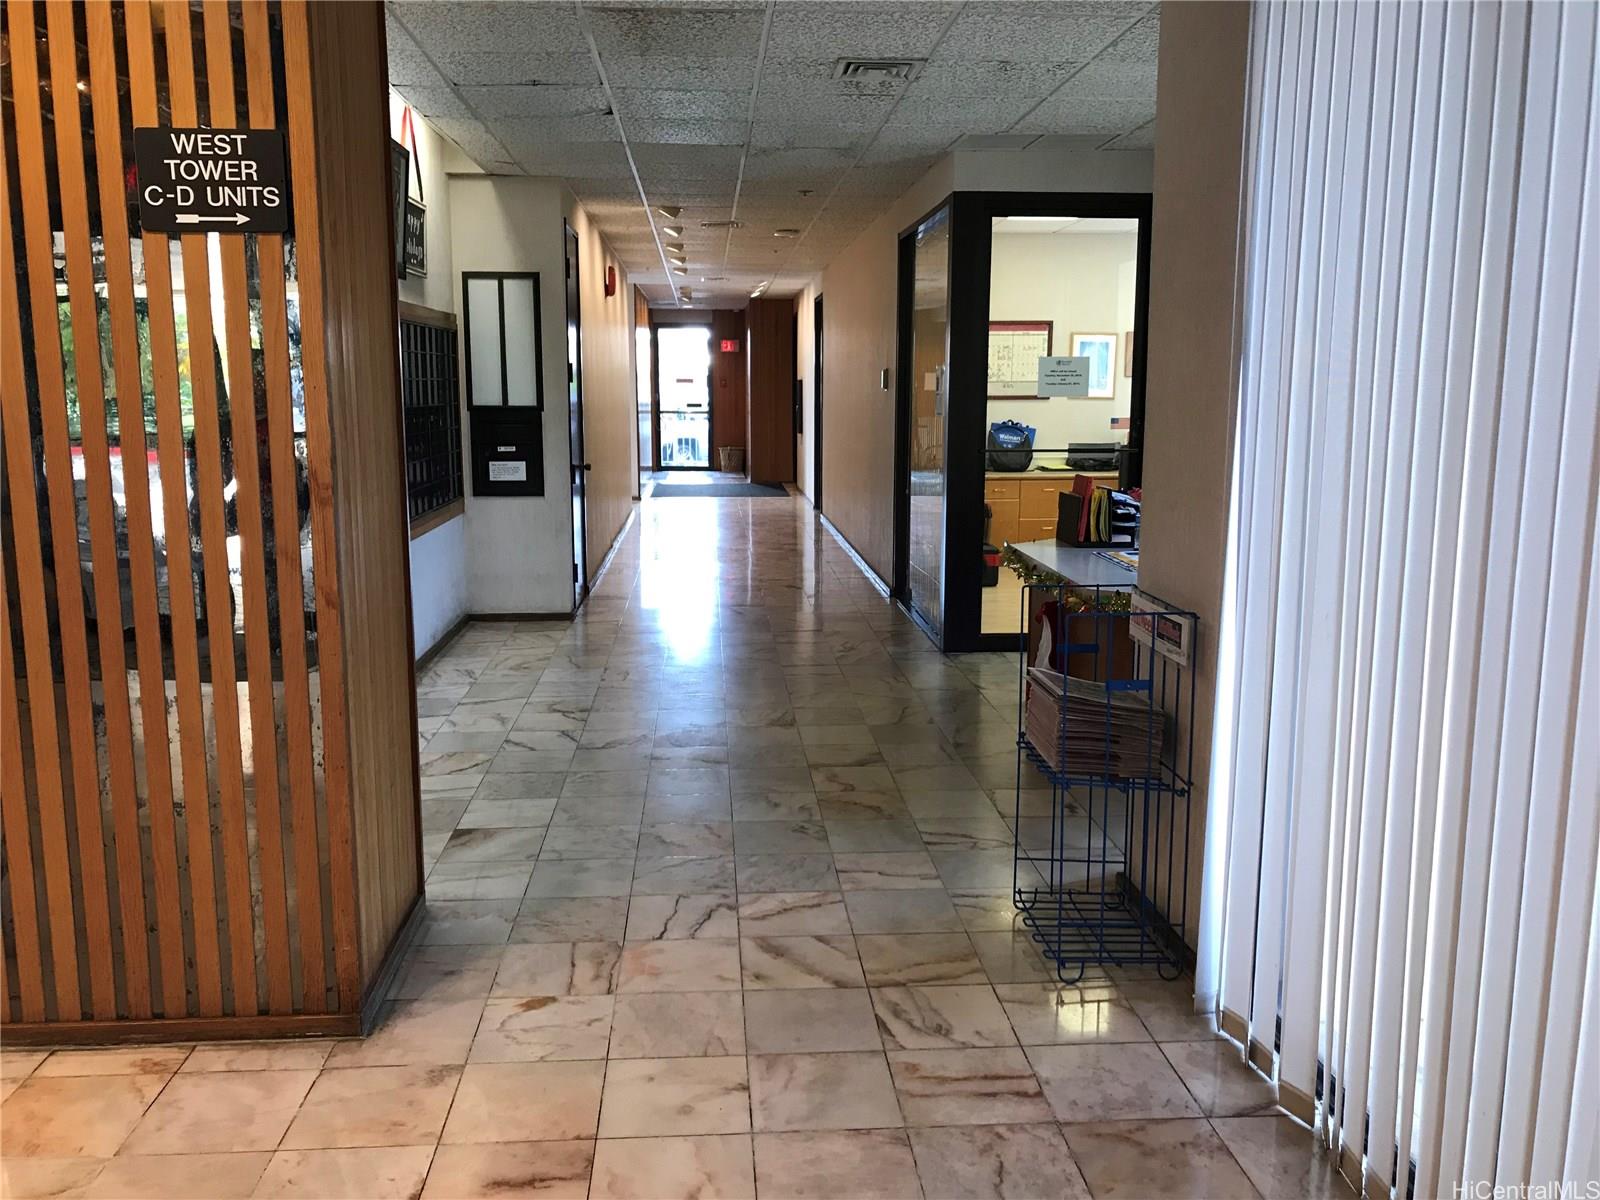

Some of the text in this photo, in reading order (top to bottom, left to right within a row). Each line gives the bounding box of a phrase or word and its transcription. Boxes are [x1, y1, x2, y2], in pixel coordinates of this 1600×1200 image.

[170, 133, 247, 155] WEST
[163, 160, 257, 181] TOWER
[144, 185, 280, 207] C-D UNITS
